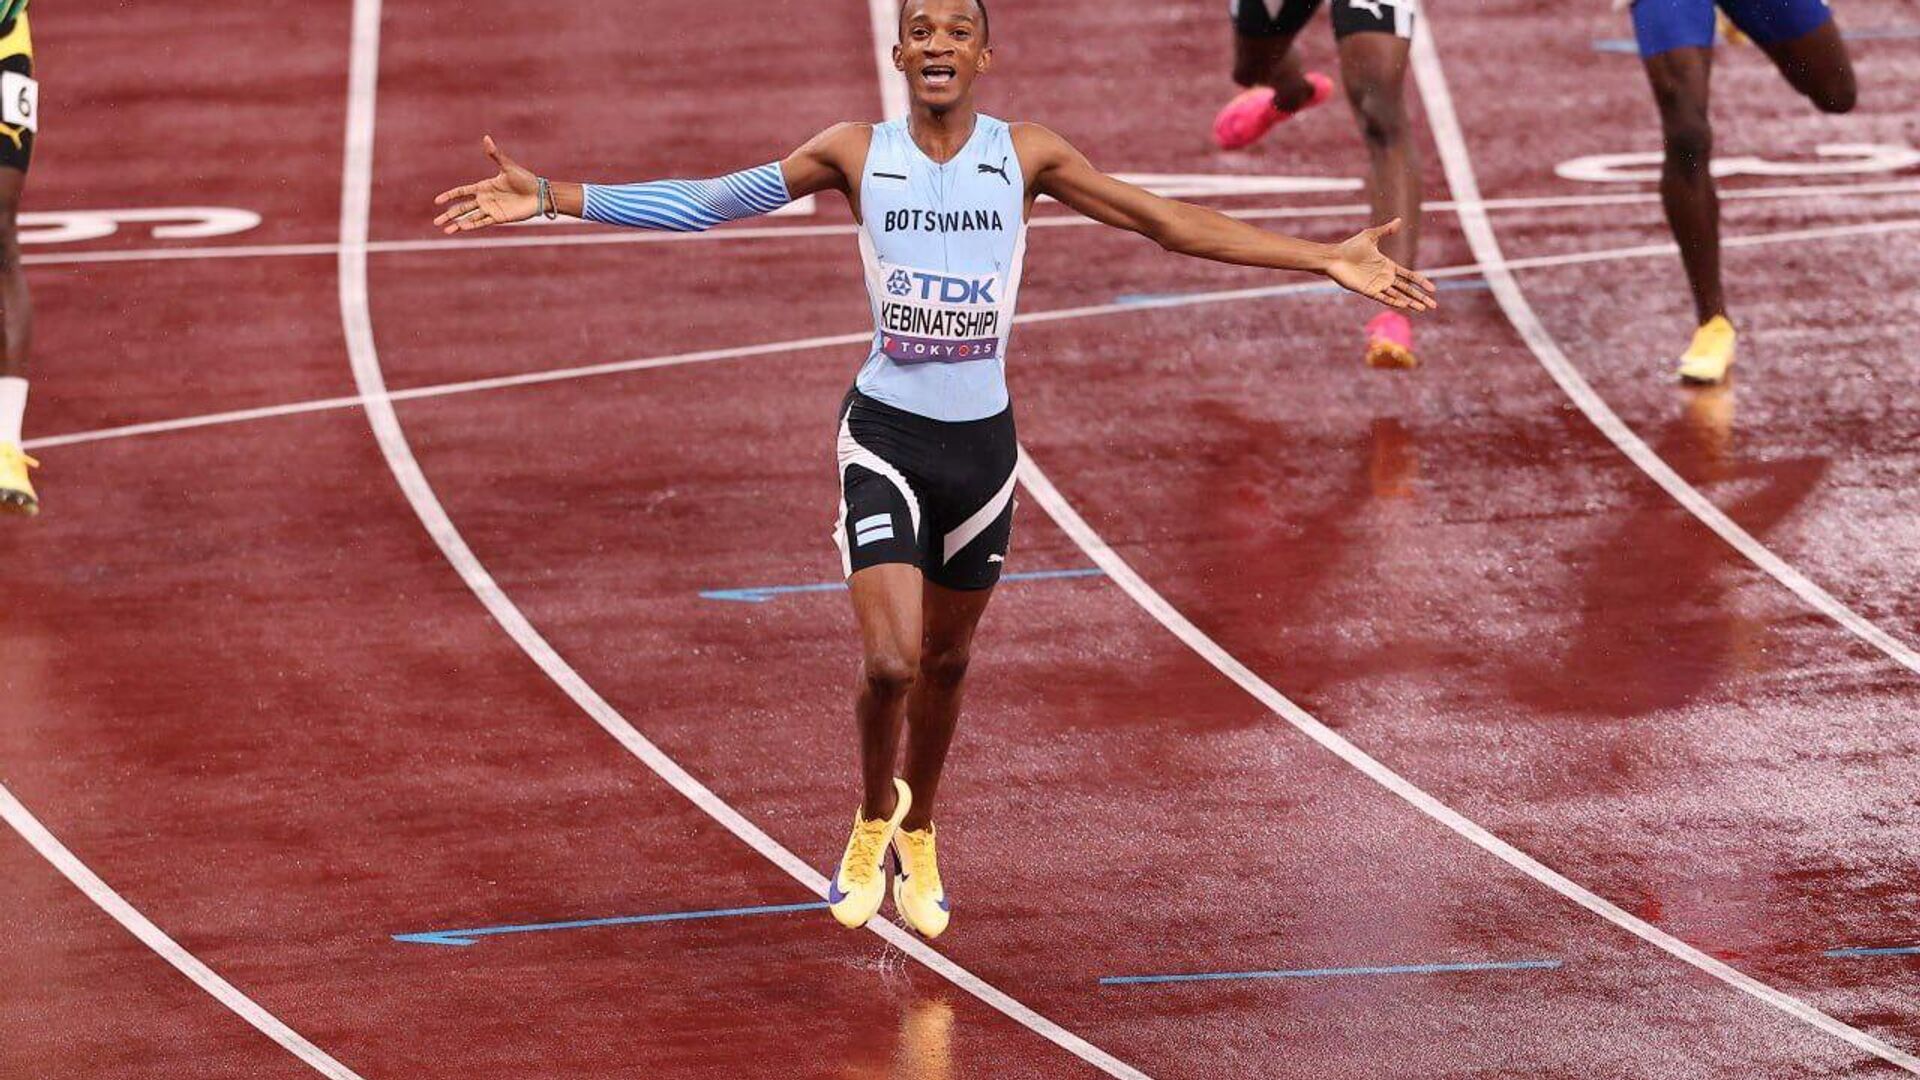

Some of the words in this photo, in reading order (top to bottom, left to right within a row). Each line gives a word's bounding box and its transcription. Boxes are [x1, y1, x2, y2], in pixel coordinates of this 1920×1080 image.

[18, 86, 31, 118] 6
[884, 208, 1003, 233] BOTSWANA
[912, 272, 996, 304] TDK
[881, 301, 999, 337] KEBINATSHIPI
